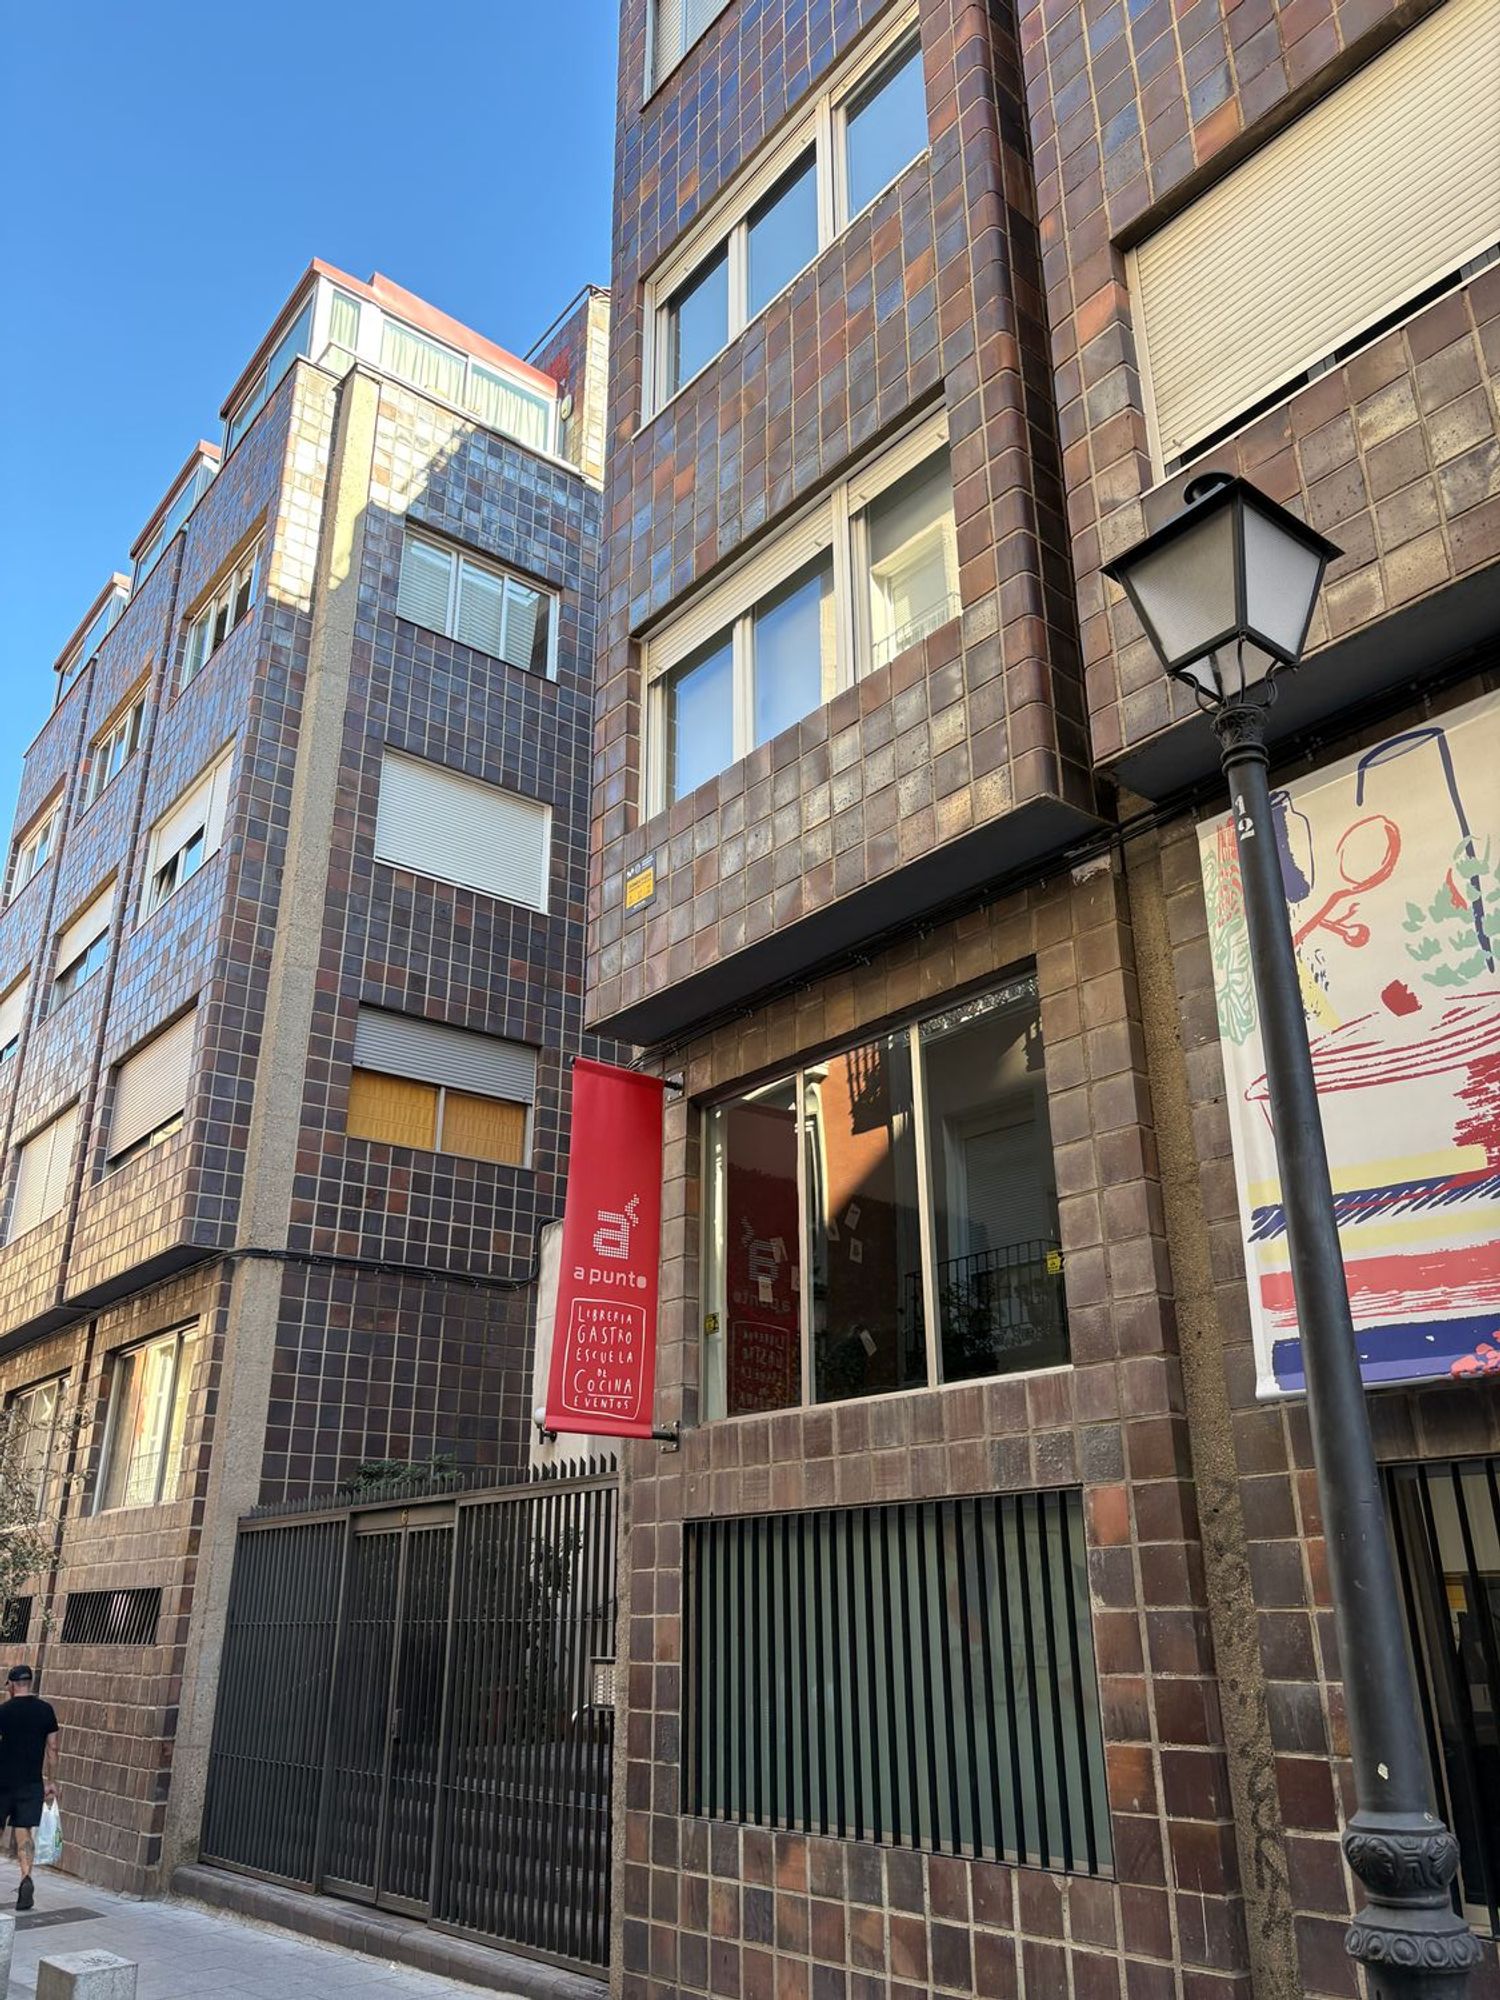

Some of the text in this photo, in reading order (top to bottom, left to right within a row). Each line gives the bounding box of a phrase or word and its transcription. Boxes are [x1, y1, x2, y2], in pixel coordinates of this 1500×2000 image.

[573, 1266, 647, 1289] a punto
[577, 1324, 632, 1345] GASTRO
[576, 1347, 633, 1364] ESCUELA
[574, 1369, 632, 1394] COCINA
[597, 1368, 607, 1378] DE
[574, 1395, 629, 1409] EVENTOS
